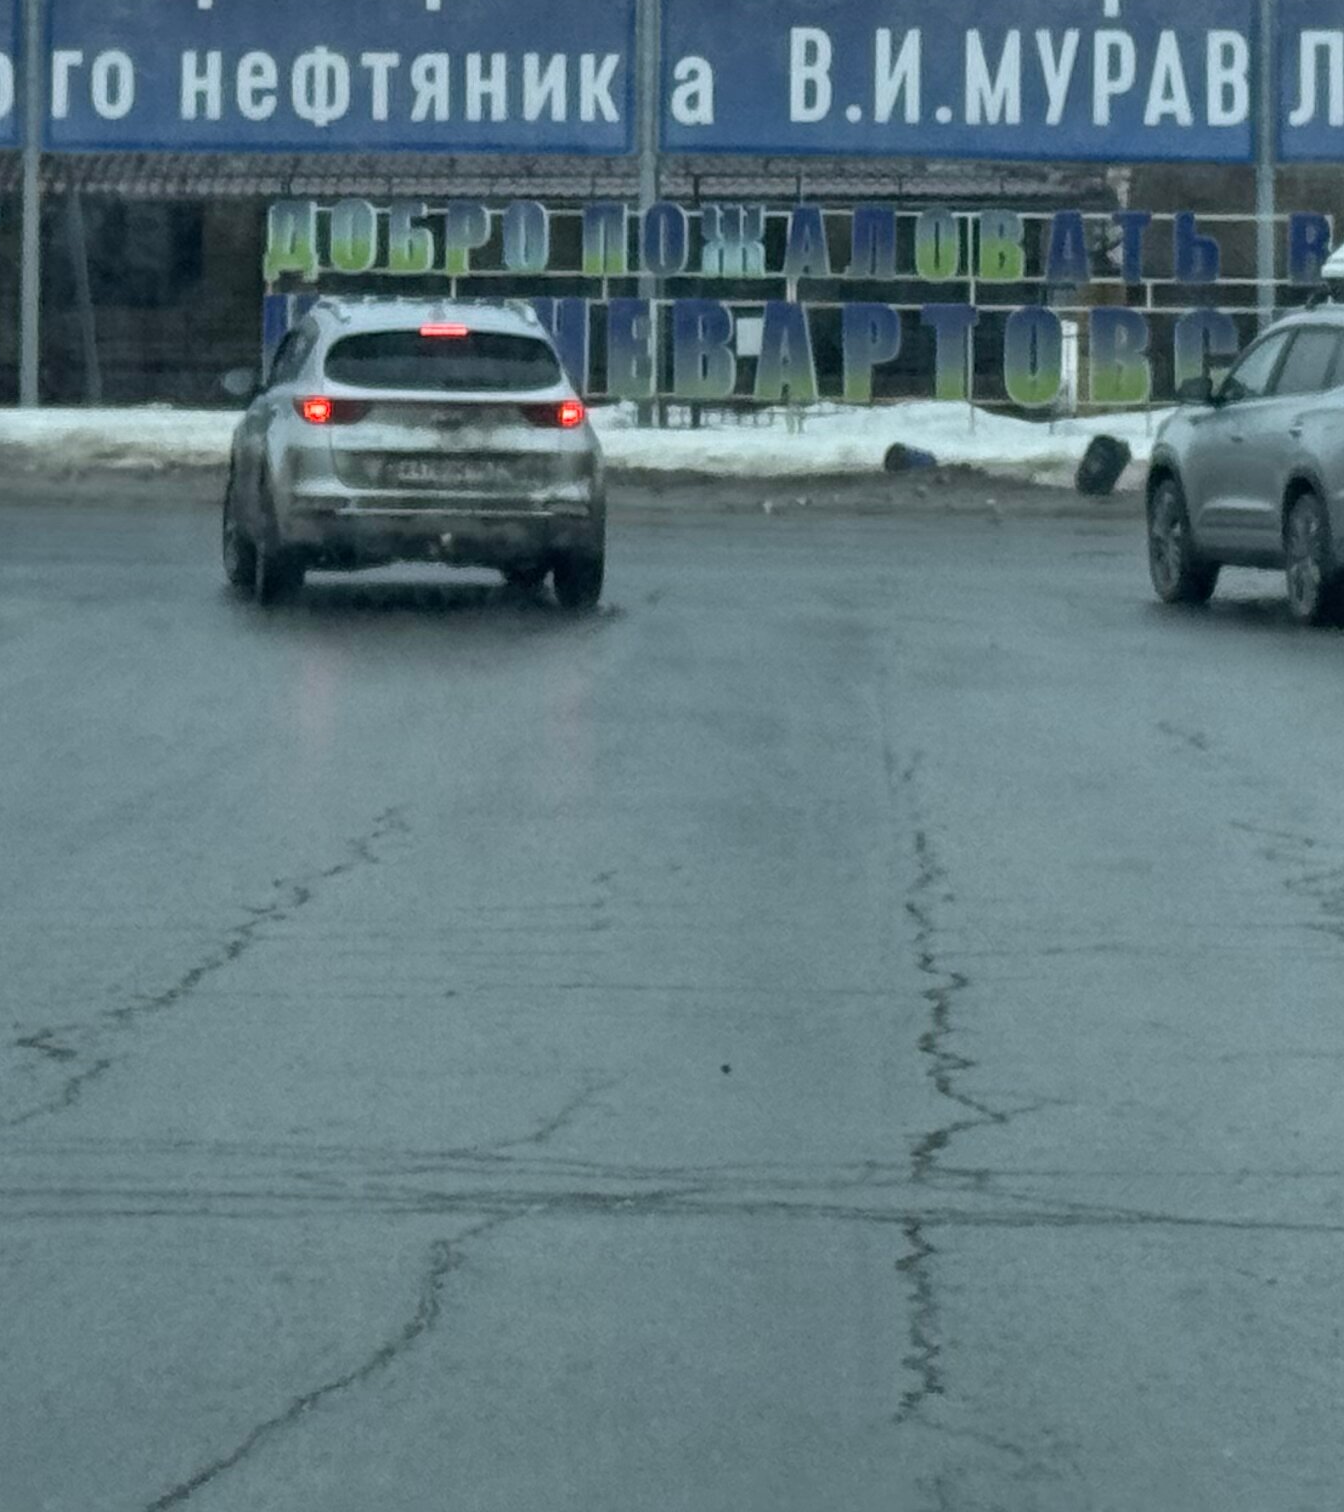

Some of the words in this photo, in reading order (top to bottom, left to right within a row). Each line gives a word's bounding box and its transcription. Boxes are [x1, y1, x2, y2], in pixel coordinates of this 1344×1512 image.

[180, 45, 715, 128] нефтяника
[264, 198, 551, 284] ДОБРО
[582, 201, 1222, 284] ПОЖАЛОВАТЬ
[1288, 210, 1333, 284] В
